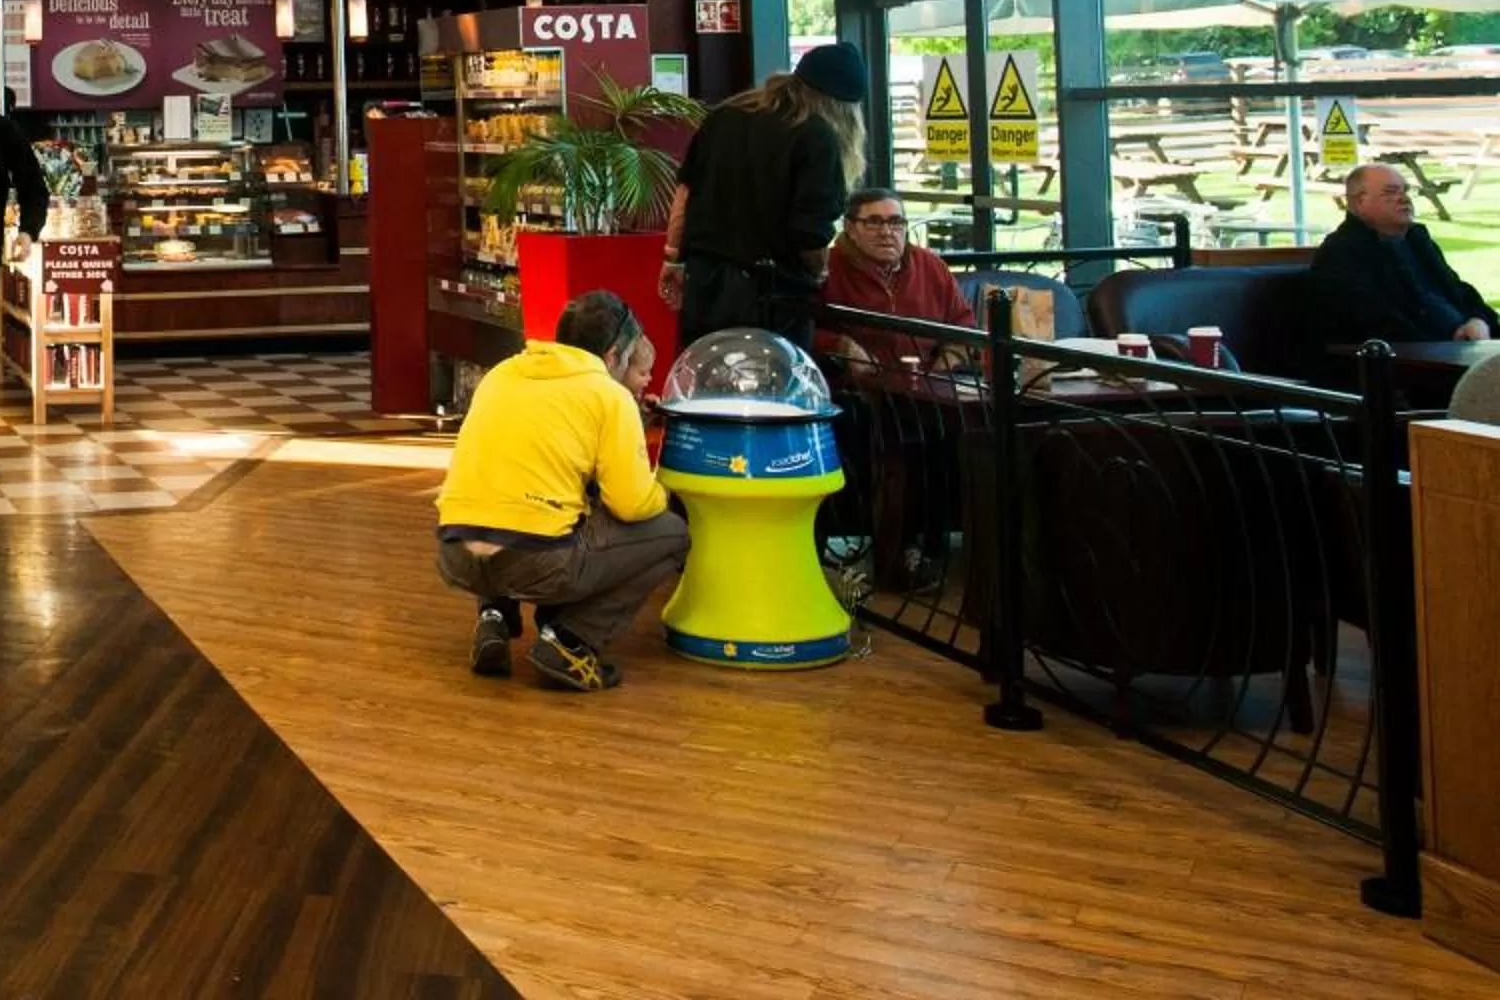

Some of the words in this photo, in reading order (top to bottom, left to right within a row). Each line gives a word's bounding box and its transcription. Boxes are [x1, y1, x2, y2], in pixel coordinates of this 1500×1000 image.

[109, 12, 149, 29] detail
[204, 6, 249, 27] treat
[533, 13, 637, 43] COSTA
[927, 126, 967, 145] Danger
[991, 126, 1035, 147] Danger
[59, 244, 99, 256] COSTA
[45, 260, 79, 269] PLEASE
[81, 260, 113, 269] QUEUE
[51, 270, 83, 279] EITHER
[86, 270, 107, 279] SIDE
